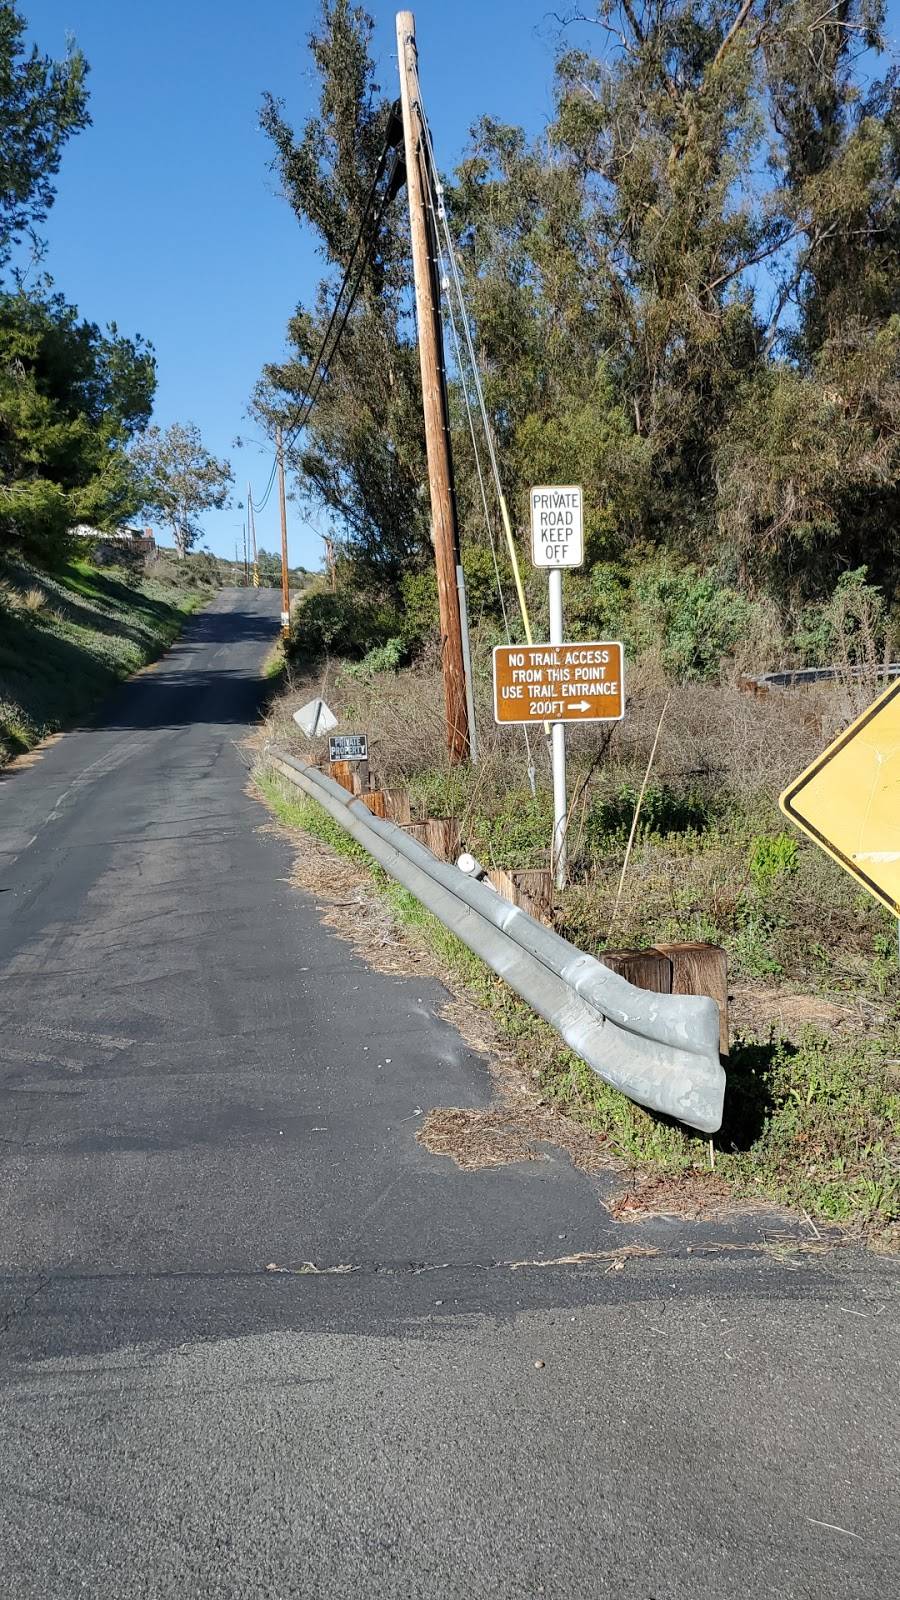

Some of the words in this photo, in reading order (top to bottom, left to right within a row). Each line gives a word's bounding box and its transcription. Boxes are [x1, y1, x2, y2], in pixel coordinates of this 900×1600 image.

[533, 493, 579, 509] PRIVATE
[540, 511, 573, 526] ROAD
[541, 528, 573, 543] KEEP
[545, 545, 568, 560] OFF
[508, 654, 524, 667] NO
[529, 652, 560, 666] TRAIL
[564, 650, 609, 664] ACCESS
[512, 669, 542, 683] FROM
[547, 668, 570, 681] THIS
[574, 667, 606, 680] POINT
[502, 686, 523, 699] USE
[528, 684, 558, 698] TRAIL
[561, 682, 618, 697] ENTRANCE
[529, 701, 565, 715] 200FT
[334, 737, 361, 747] PRIVATE
[331, 745, 366, 755] PROPERTY
